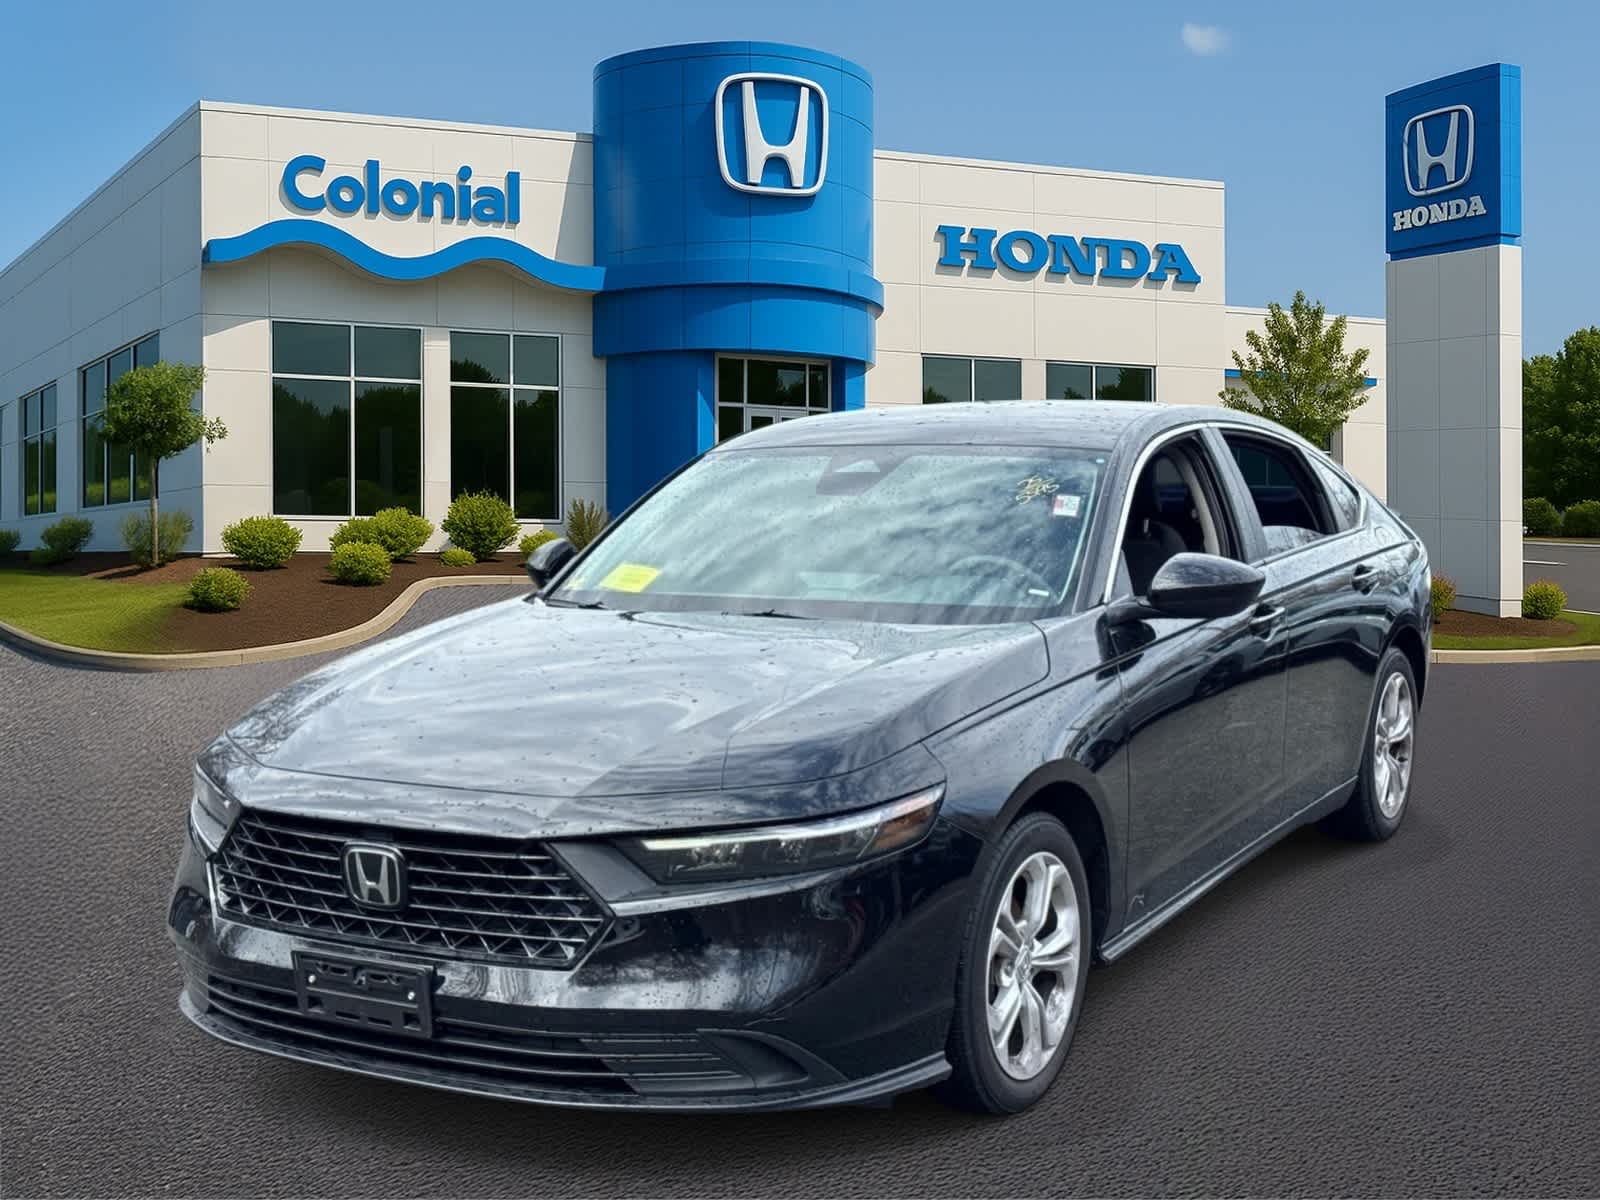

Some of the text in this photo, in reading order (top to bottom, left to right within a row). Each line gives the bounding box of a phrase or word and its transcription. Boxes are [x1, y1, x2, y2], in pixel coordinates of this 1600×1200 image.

[281, 153, 521, 227] Colonial
[1392, 194, 1487, 232] HONDA
[936, 224, 1201, 284] HONDA
